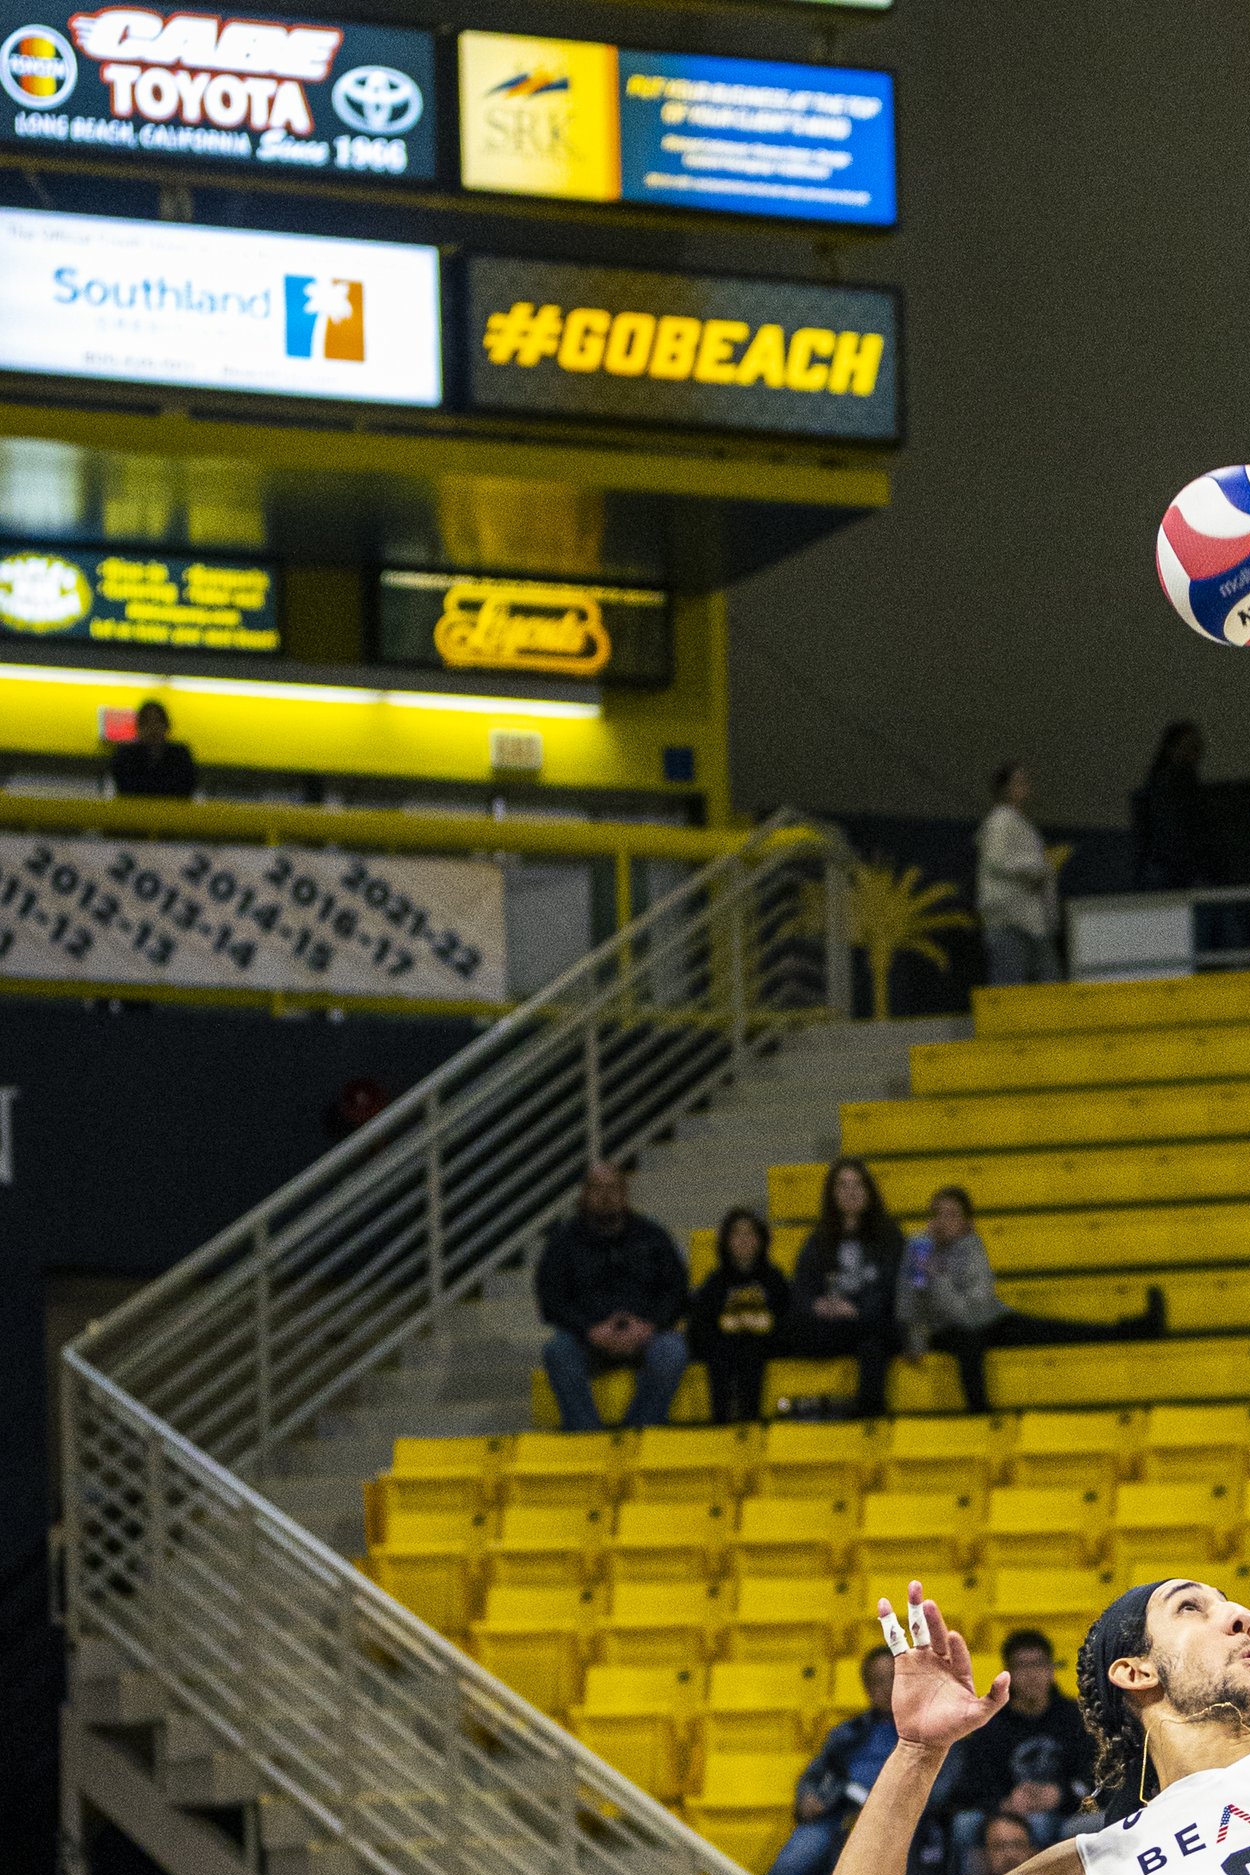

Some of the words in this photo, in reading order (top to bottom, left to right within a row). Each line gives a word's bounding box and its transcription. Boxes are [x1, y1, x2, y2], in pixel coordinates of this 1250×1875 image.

[104, 65, 311, 134] TOYOTA
[139, 123, 251, 158] CALIFORNIA
[53, 265, 271, 320] Southland
[483, 301, 883, 397] #GOBEACH
[0, 873, 94, 961] 11-12
